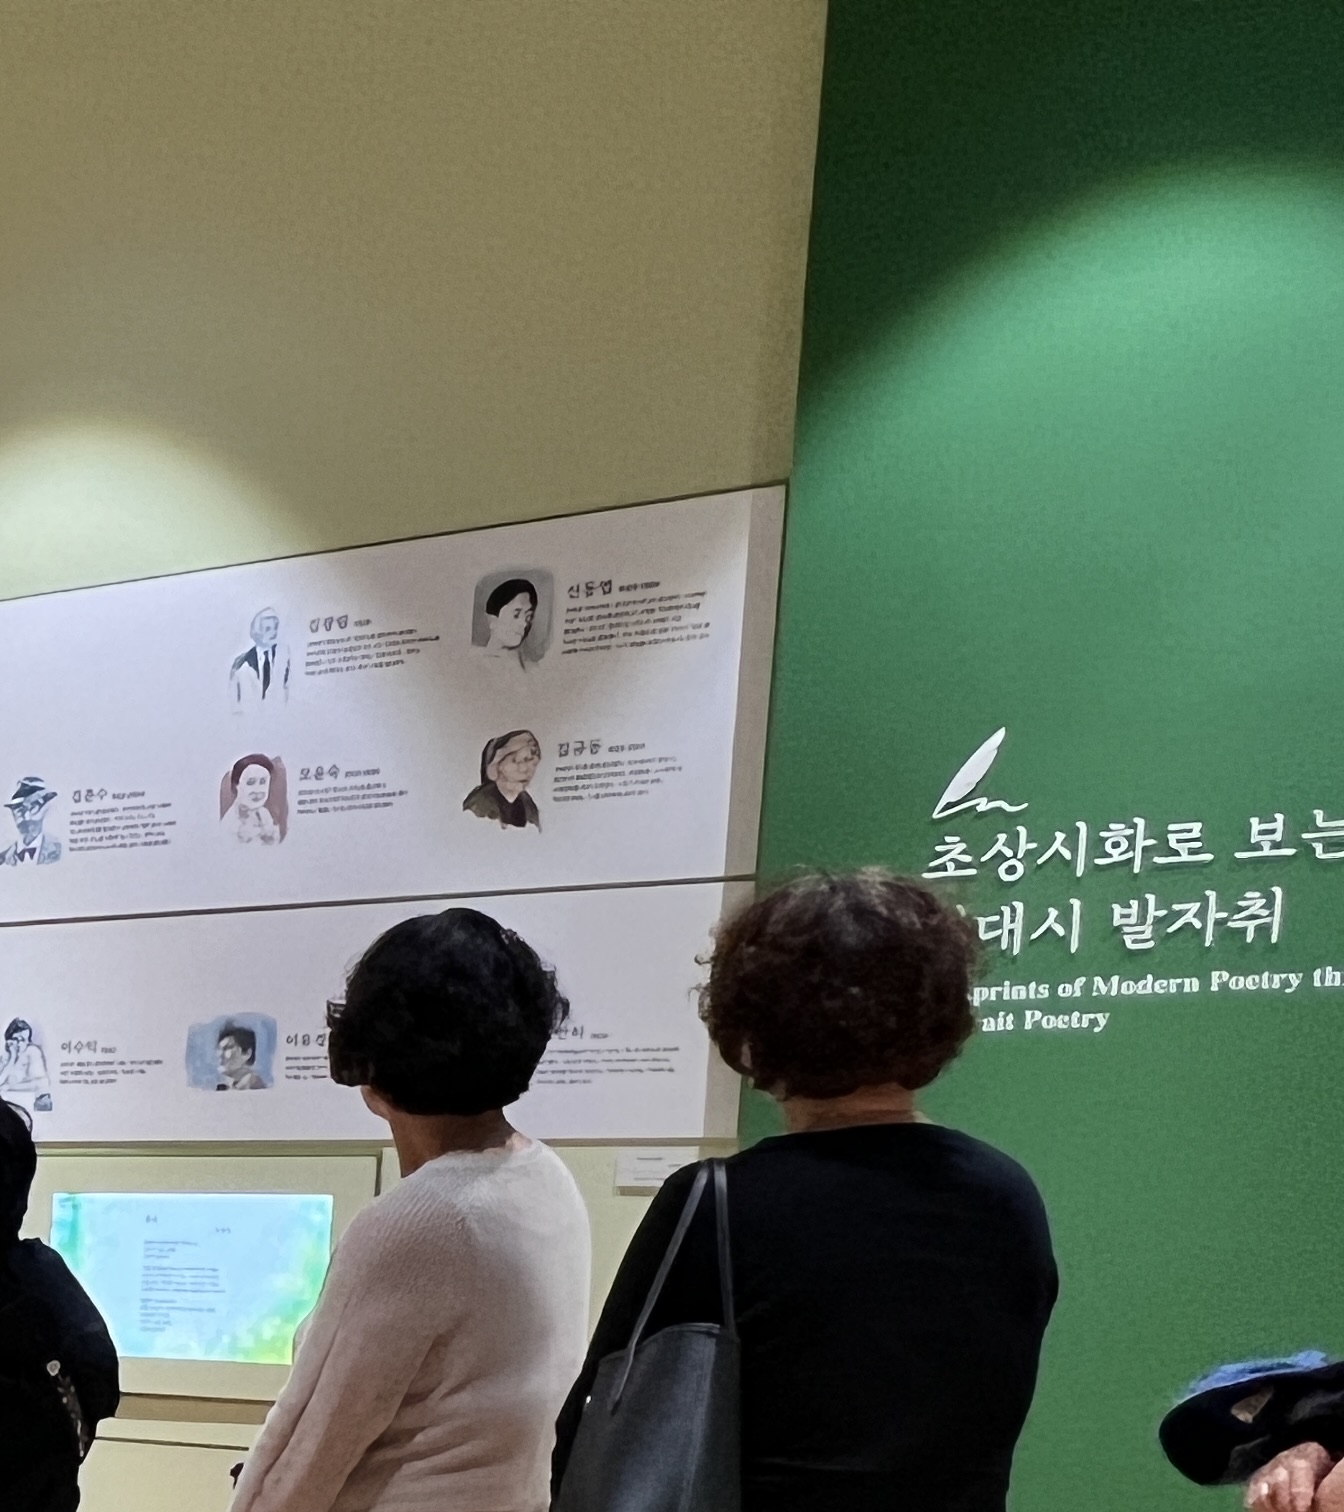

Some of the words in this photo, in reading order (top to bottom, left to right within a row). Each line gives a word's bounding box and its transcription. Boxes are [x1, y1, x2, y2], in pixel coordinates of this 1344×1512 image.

[921, 817, 1214, 882] 초상시화로
[1234, 809, 1344, 860] 보는
[956, 898, 1081, 956] 대시
[1112, 886, 1283, 950] 발자취
[968, 980, 1050, 1007] prints
[1057, 976, 1086, 998] of
[1092, 973, 1200, 997] Modern
[1210, 970, 1304, 994] Poetry
[1313, 966, 1344, 987] th
[1024, 1009, 1111, 1033] Poetry
